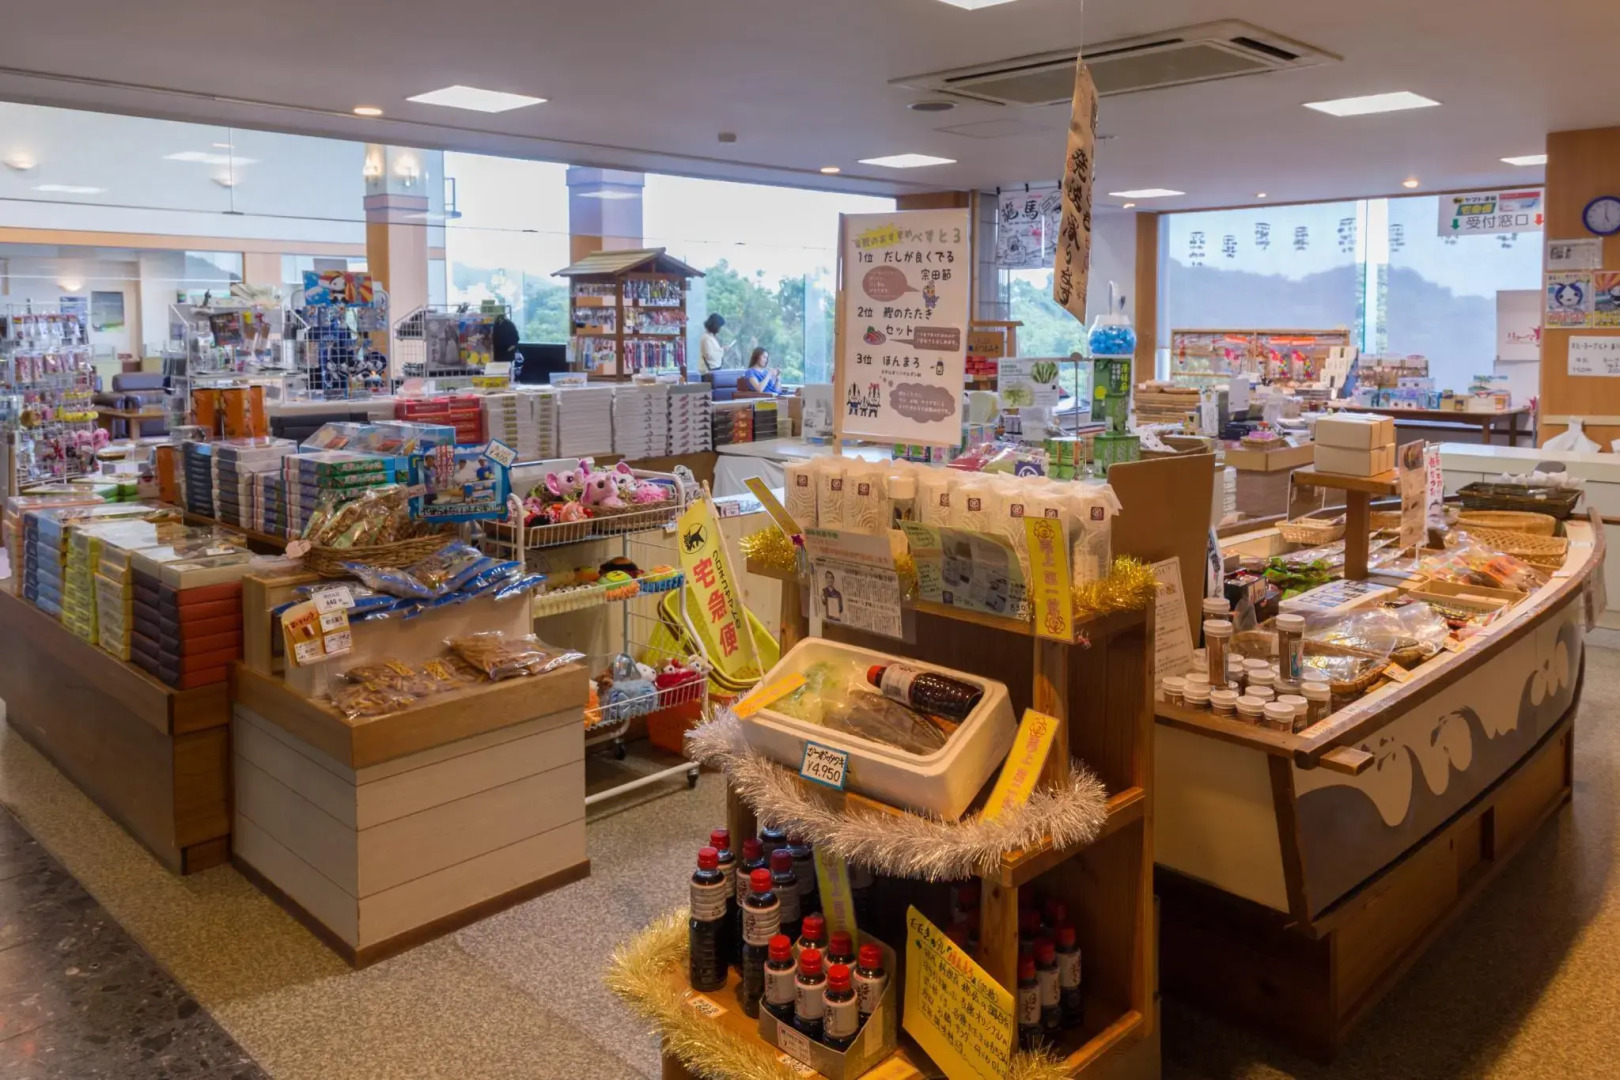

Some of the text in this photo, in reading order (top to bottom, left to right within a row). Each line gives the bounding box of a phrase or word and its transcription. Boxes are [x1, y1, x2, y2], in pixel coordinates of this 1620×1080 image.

[1466, 214, 1529, 230] 受付窓口
[858, 251, 954, 263] 1位 だしが良くでる
[920, 268, 951, 280] 宗田節
[857, 306, 933, 320] 2位 鰹のたたき
[886, 324, 913, 336] セット
[856, 353, 872, 365] 3位
[693, 556, 739, 658] 宅急便
